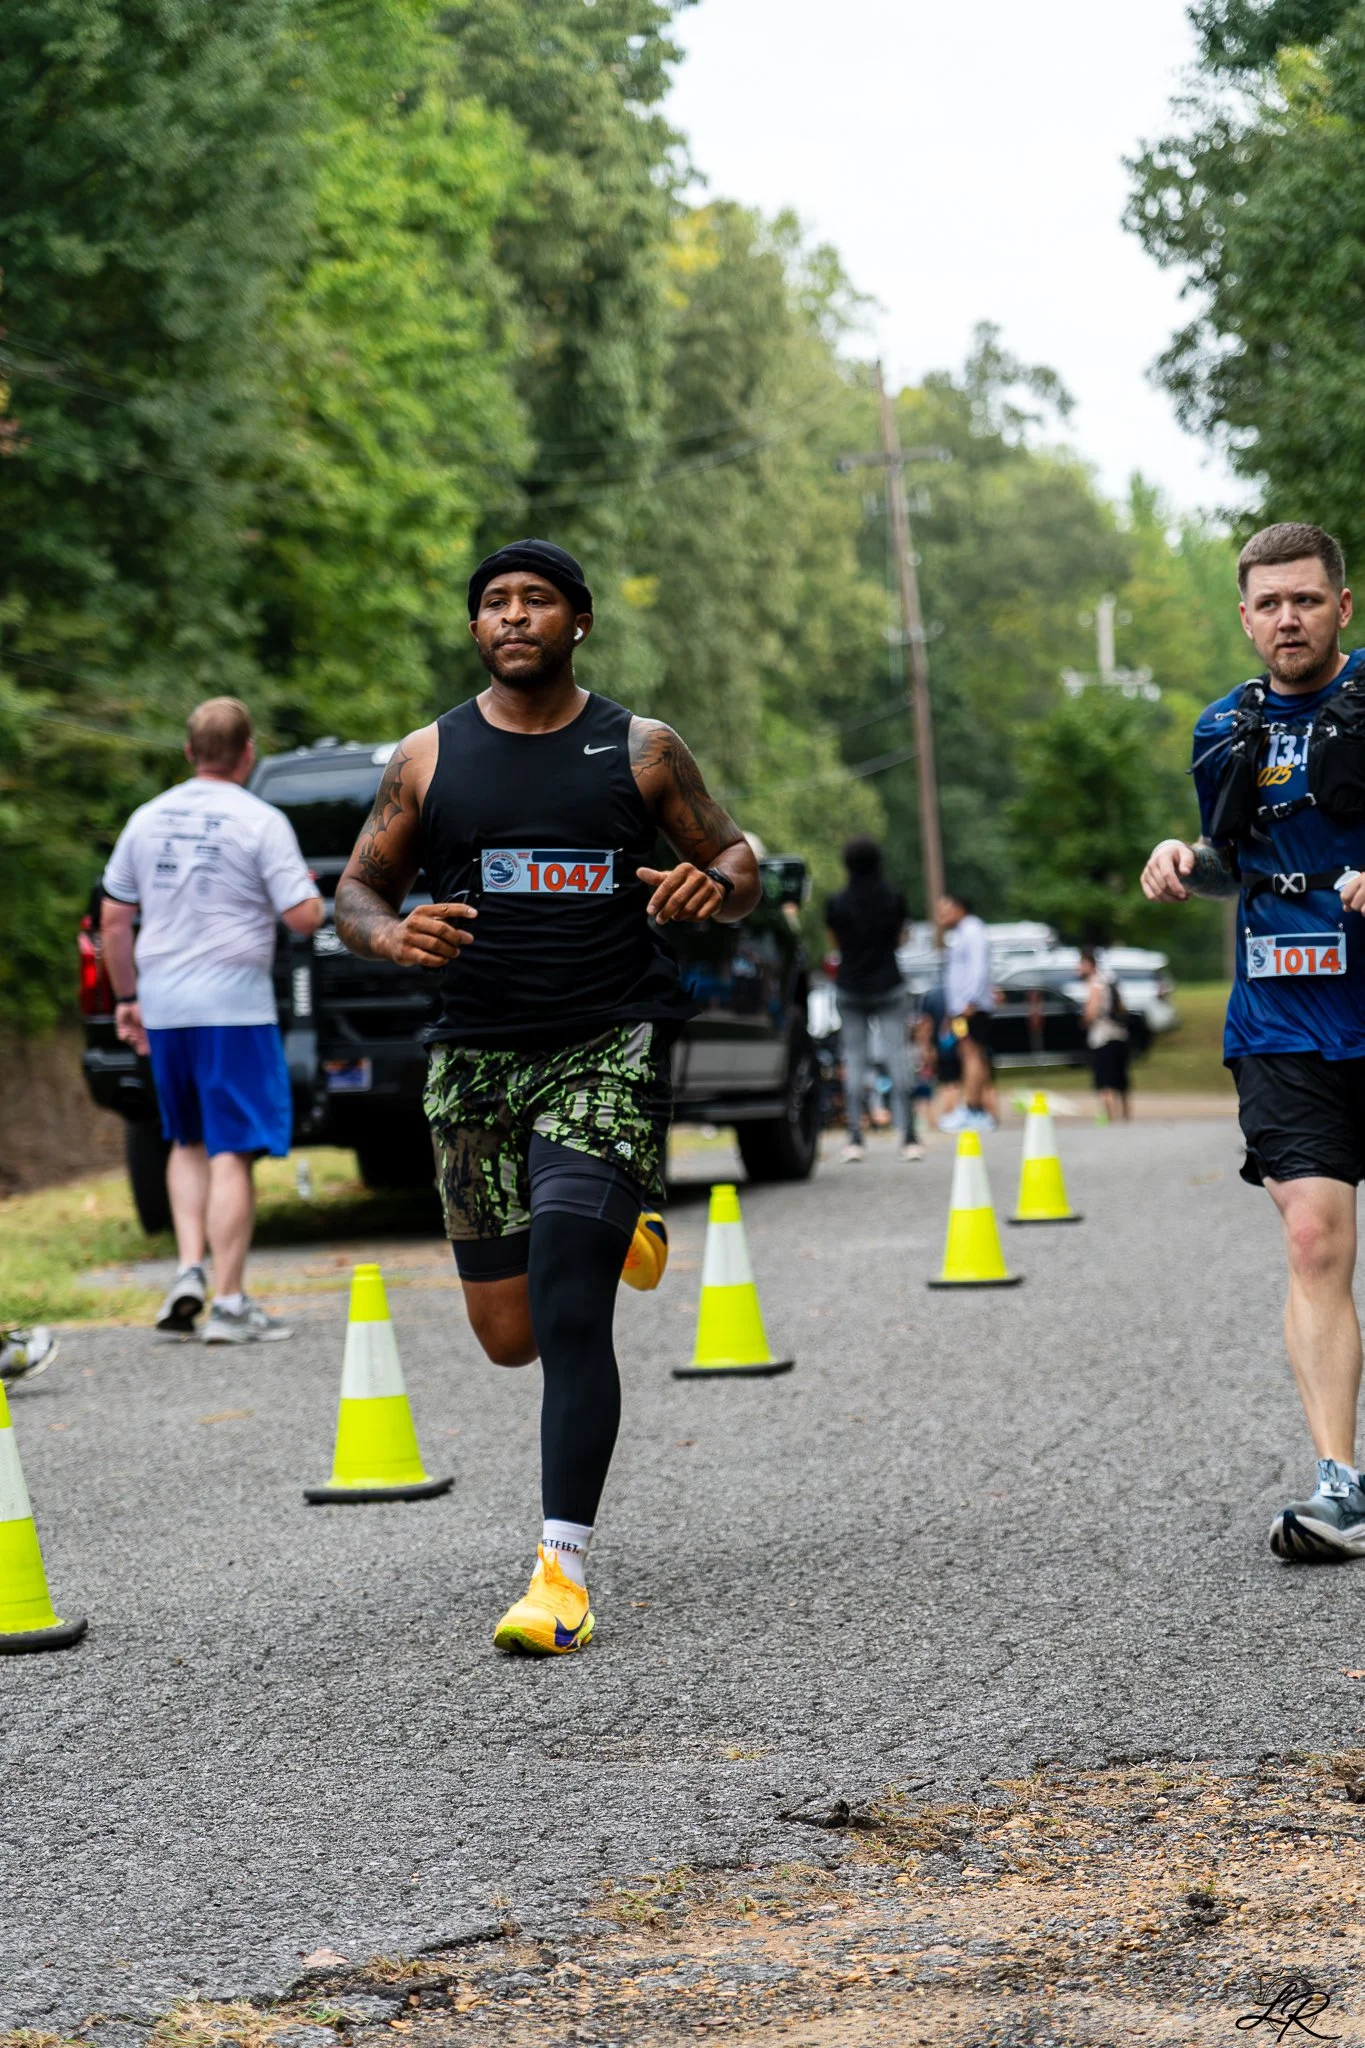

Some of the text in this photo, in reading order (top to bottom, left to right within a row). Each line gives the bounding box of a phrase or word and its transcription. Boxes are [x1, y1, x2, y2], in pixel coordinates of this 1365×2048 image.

[1267, 734, 1309, 769] 13.1
[1257, 764, 1295, 787] 025
[527, 863, 611, 893] 1047
[1273, 946, 1342, 975] 1014
